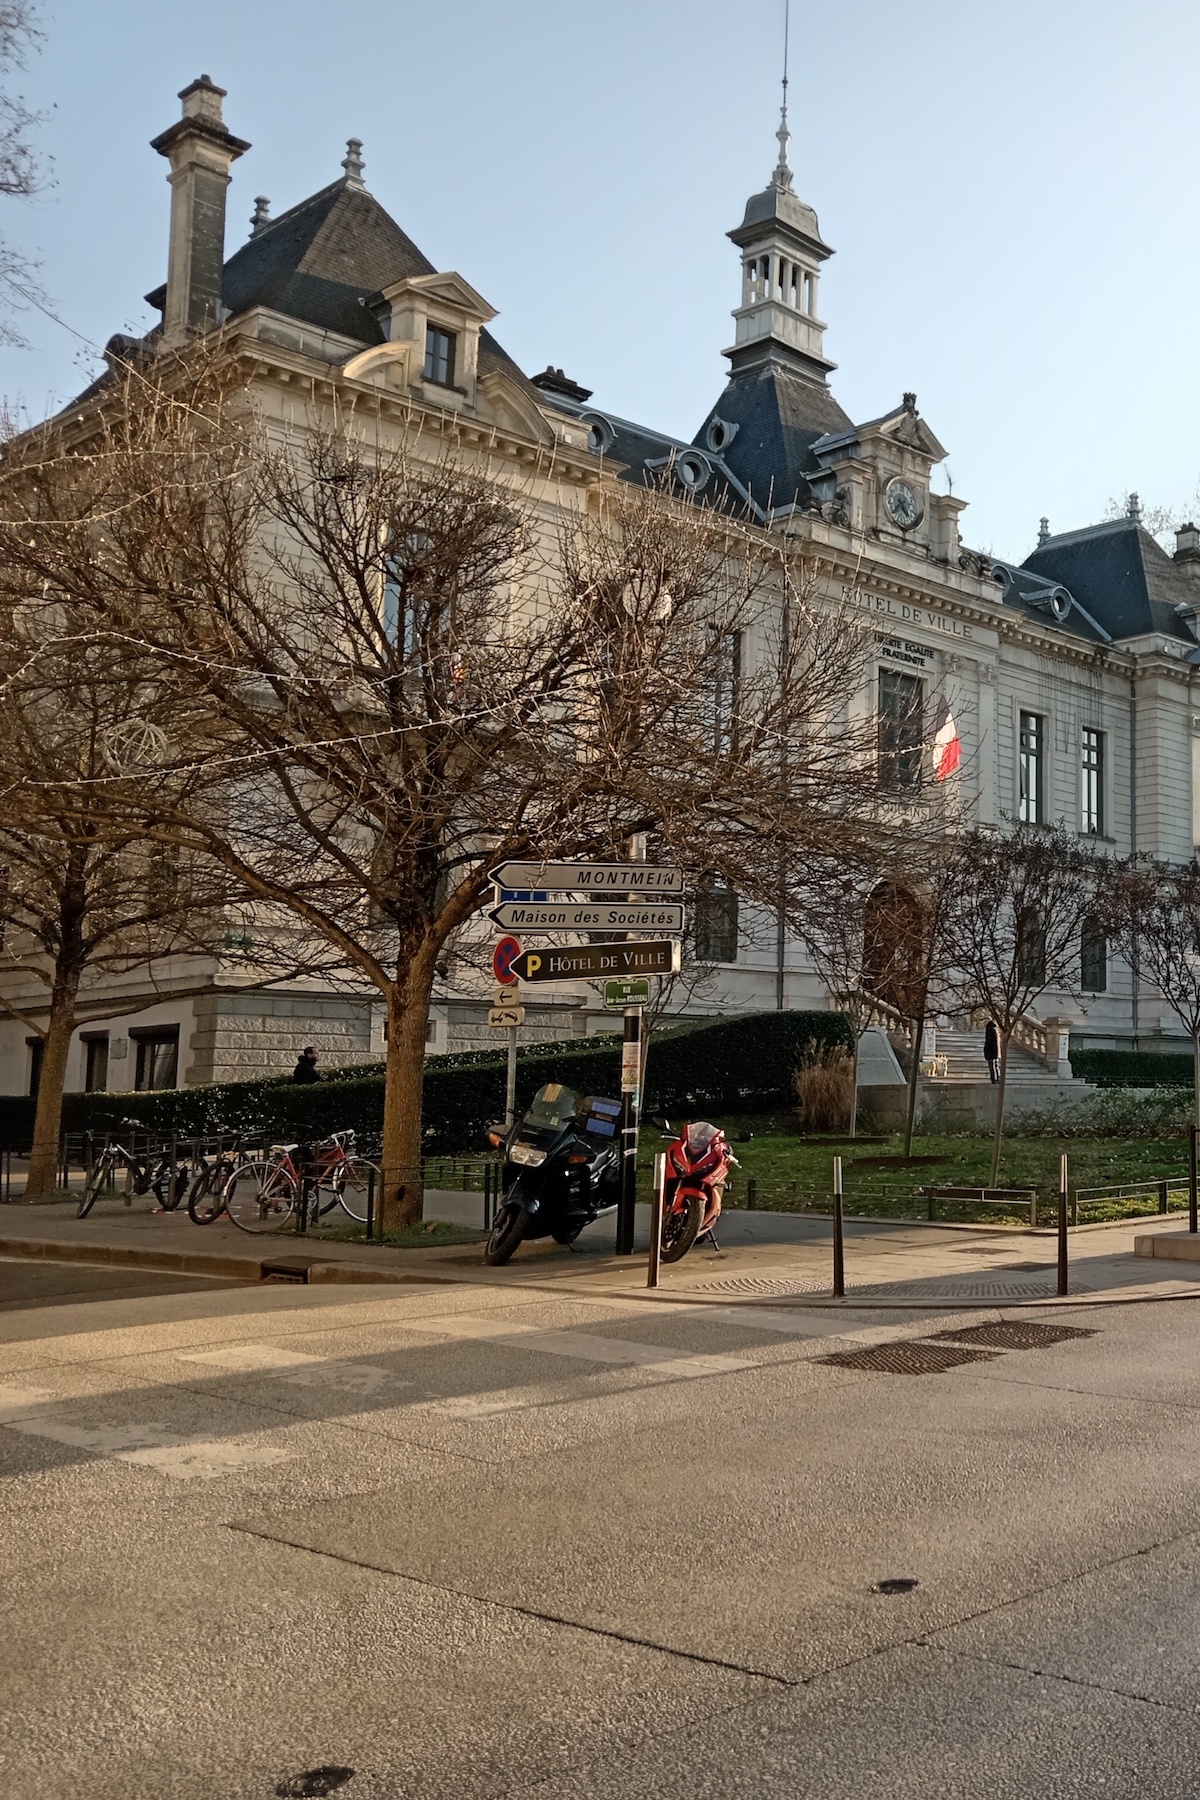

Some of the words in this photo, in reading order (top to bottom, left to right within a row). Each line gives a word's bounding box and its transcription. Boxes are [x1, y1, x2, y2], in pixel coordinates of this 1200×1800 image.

[902, 605, 921, 622] DE
[927, 613, 972, 638] VILLE
[577, 871, 674, 885] MONTMEIN
[511, 910, 565, 922] Maison
[574, 911, 600, 923] des
[607, 911, 674, 924] Sociétés
[527, 955, 542, 977] P
[549, 957, 595, 972] HÔTEL
[600, 955, 618, 968] DE
[623, 952, 665, 966] VILLE
